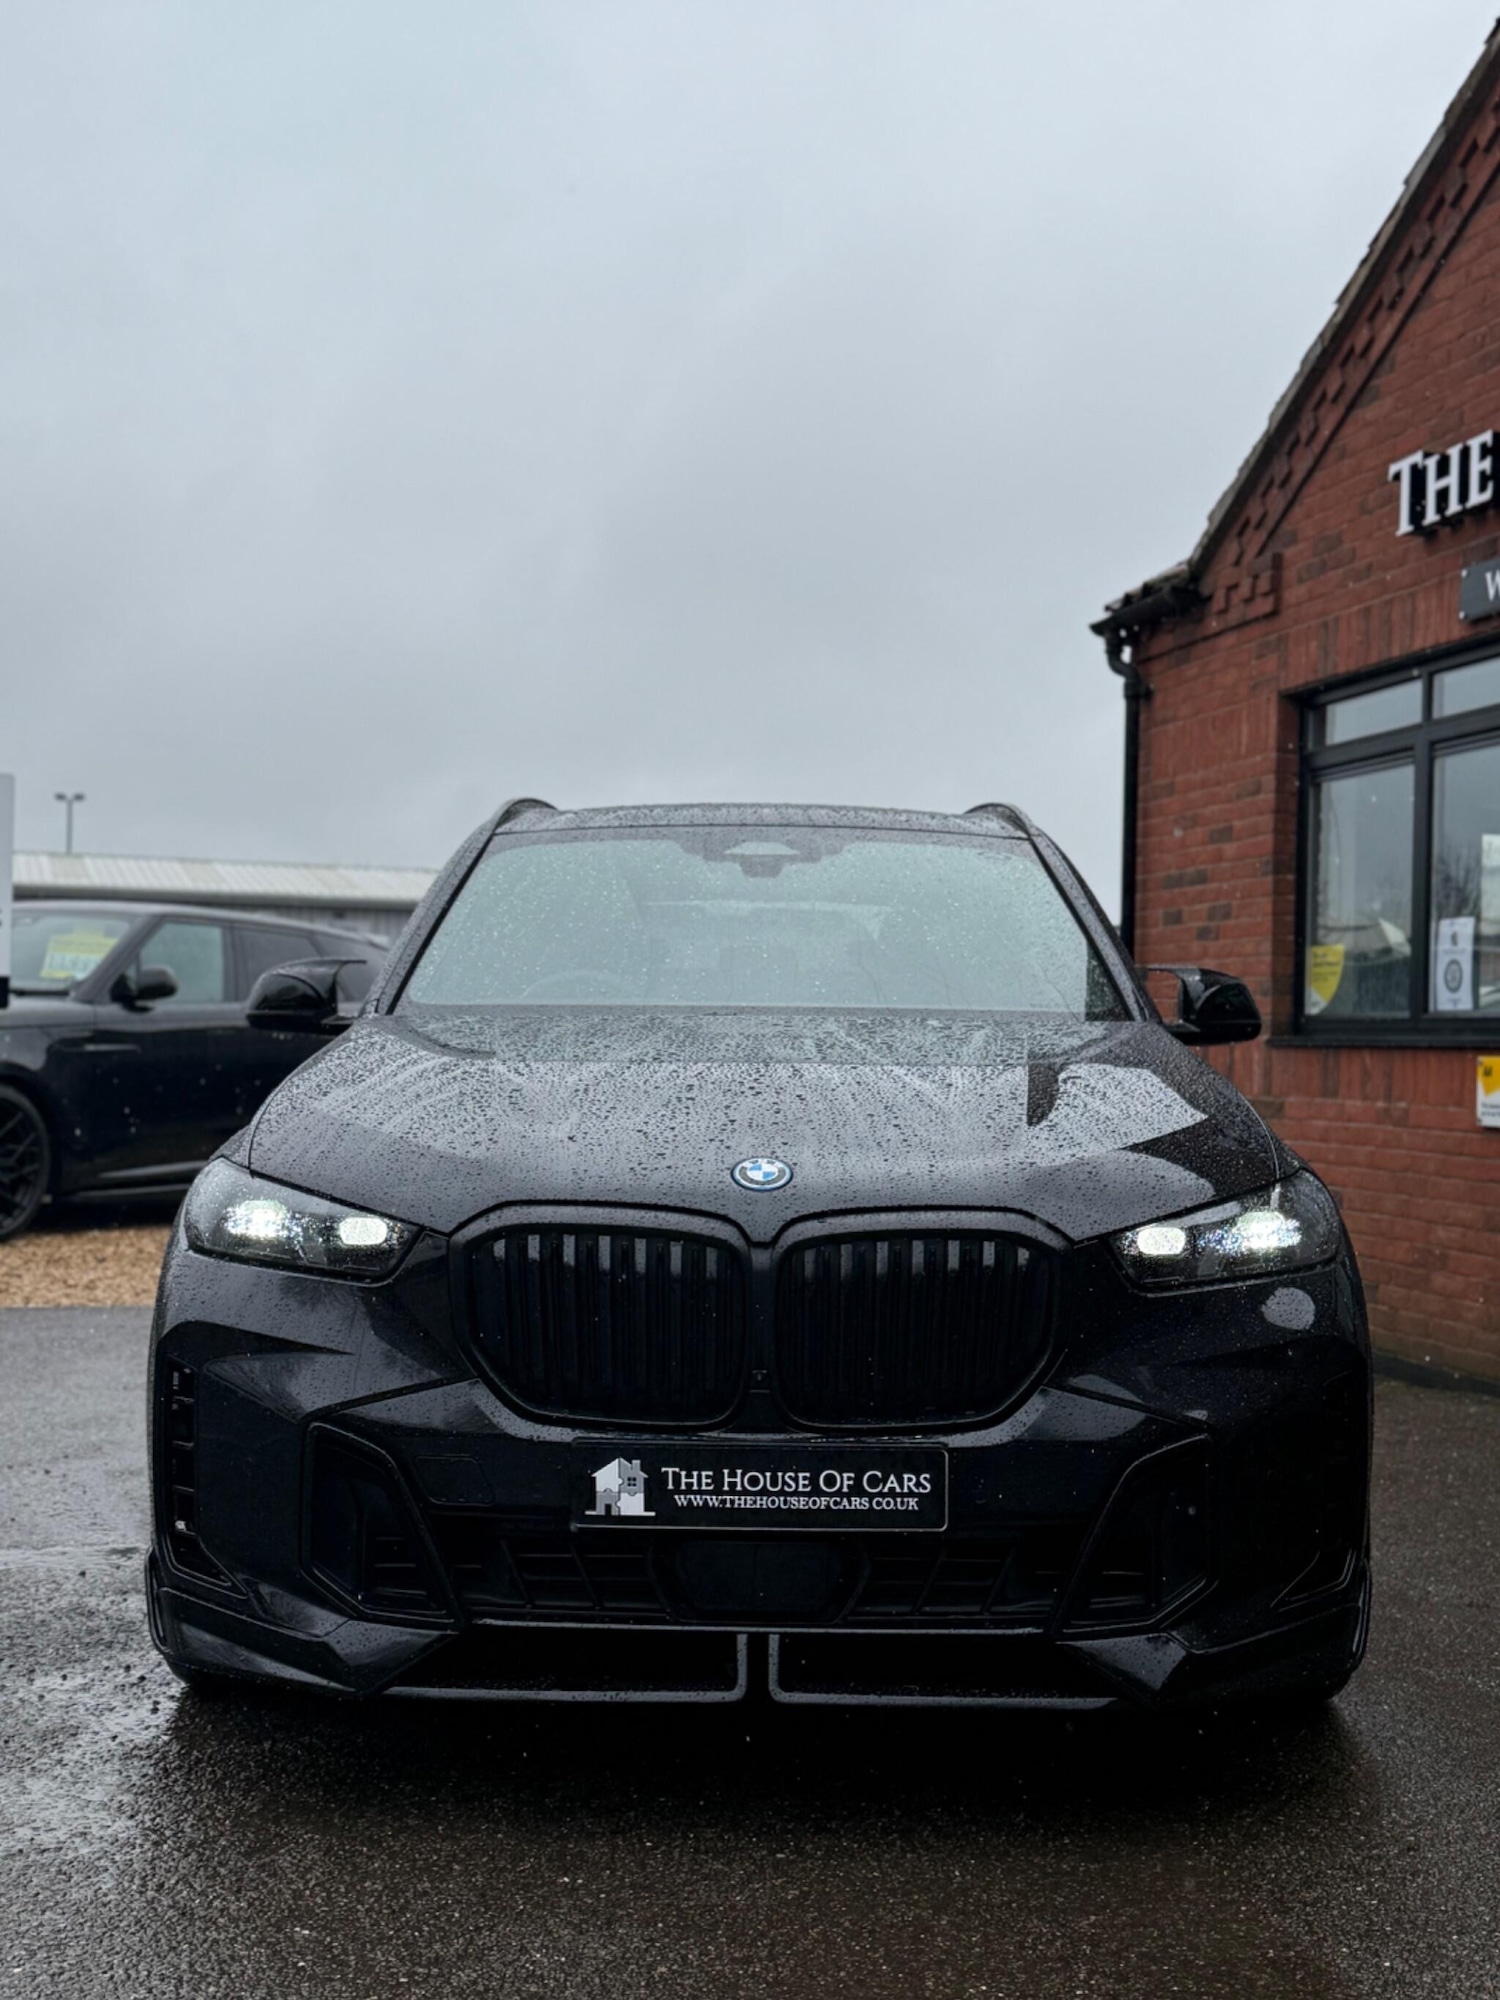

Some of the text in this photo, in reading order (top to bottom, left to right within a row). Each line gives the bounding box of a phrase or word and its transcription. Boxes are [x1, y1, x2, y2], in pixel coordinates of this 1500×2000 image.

[1387, 429, 1493, 536] THE
[661, 1467, 931, 1493] THE HOUSE OF CARS
